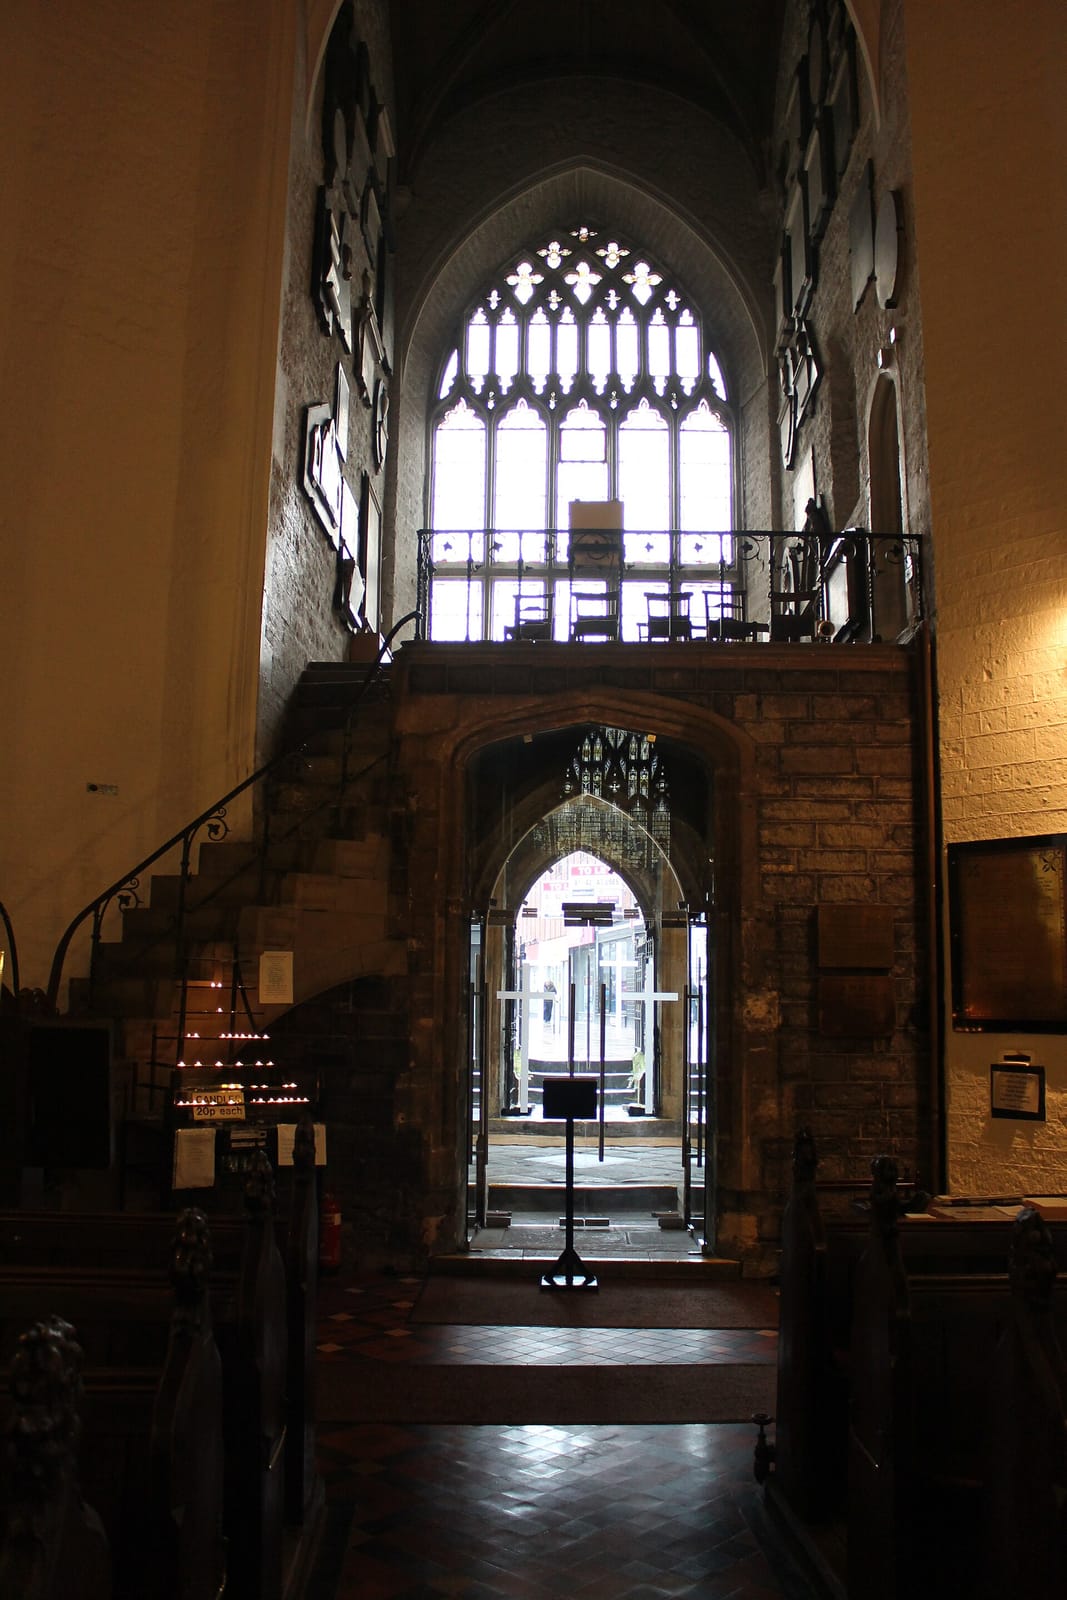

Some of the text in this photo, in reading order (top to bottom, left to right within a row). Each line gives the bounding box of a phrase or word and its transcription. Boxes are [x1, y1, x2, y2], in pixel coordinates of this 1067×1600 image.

[578, 866, 591, 875] TO
[196, 1106, 242, 1117] 20p each
